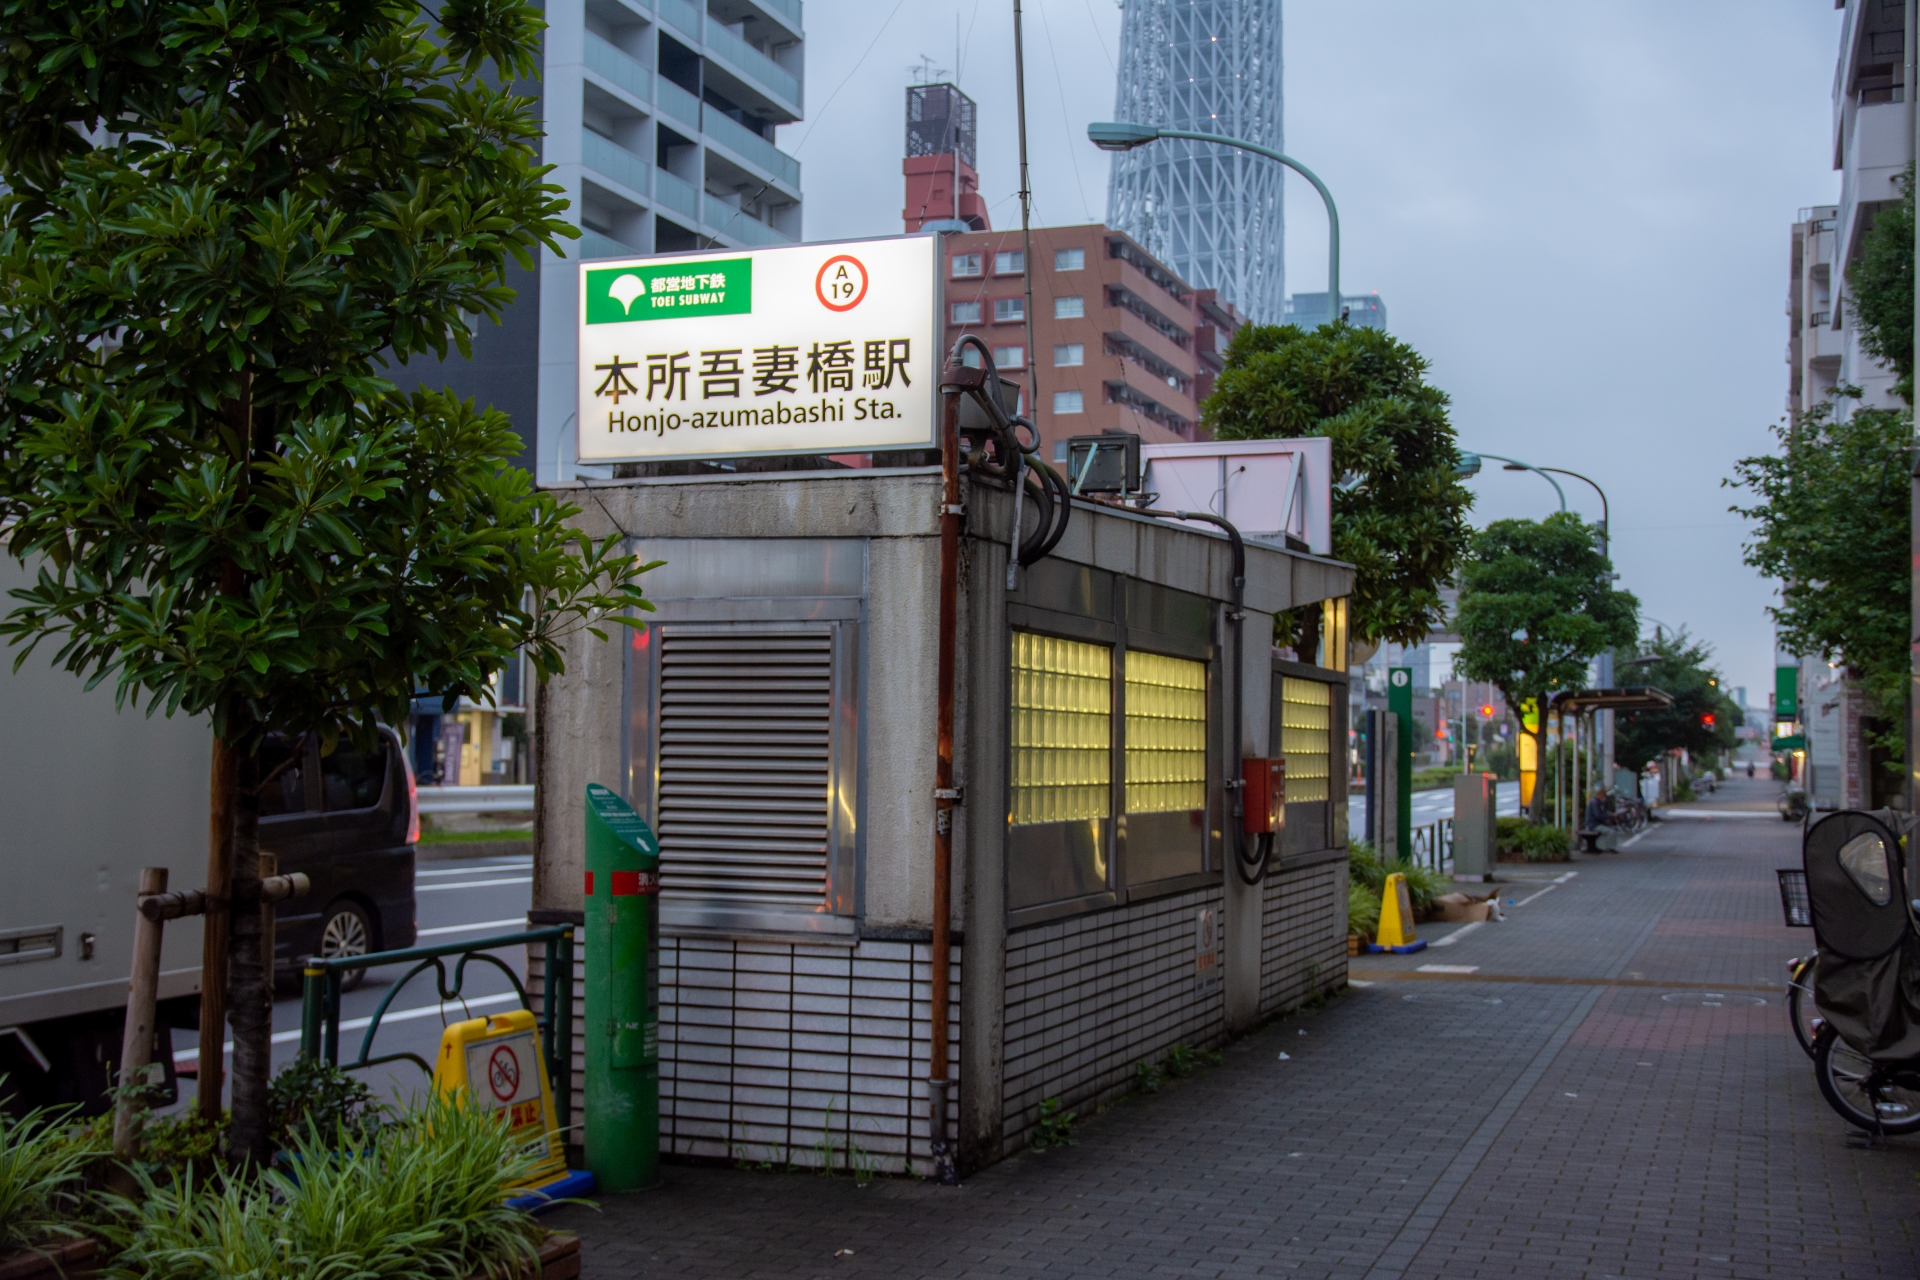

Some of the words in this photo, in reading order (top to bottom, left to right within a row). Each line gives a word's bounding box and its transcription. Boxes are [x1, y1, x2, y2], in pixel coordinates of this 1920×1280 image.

[835, 265, 848, 280] A
[650, 272, 726, 294] 都営地下鉄
[831, 282, 855, 300] 19
[650, 295, 675, 308] TOEI
[678, 291, 726, 306] SUBWAY
[594, 338, 911, 404] 本所吾妻橋駅
[608, 397, 845, 437] Honjo-azumabashi
[854, 397, 902, 421] Sta.
